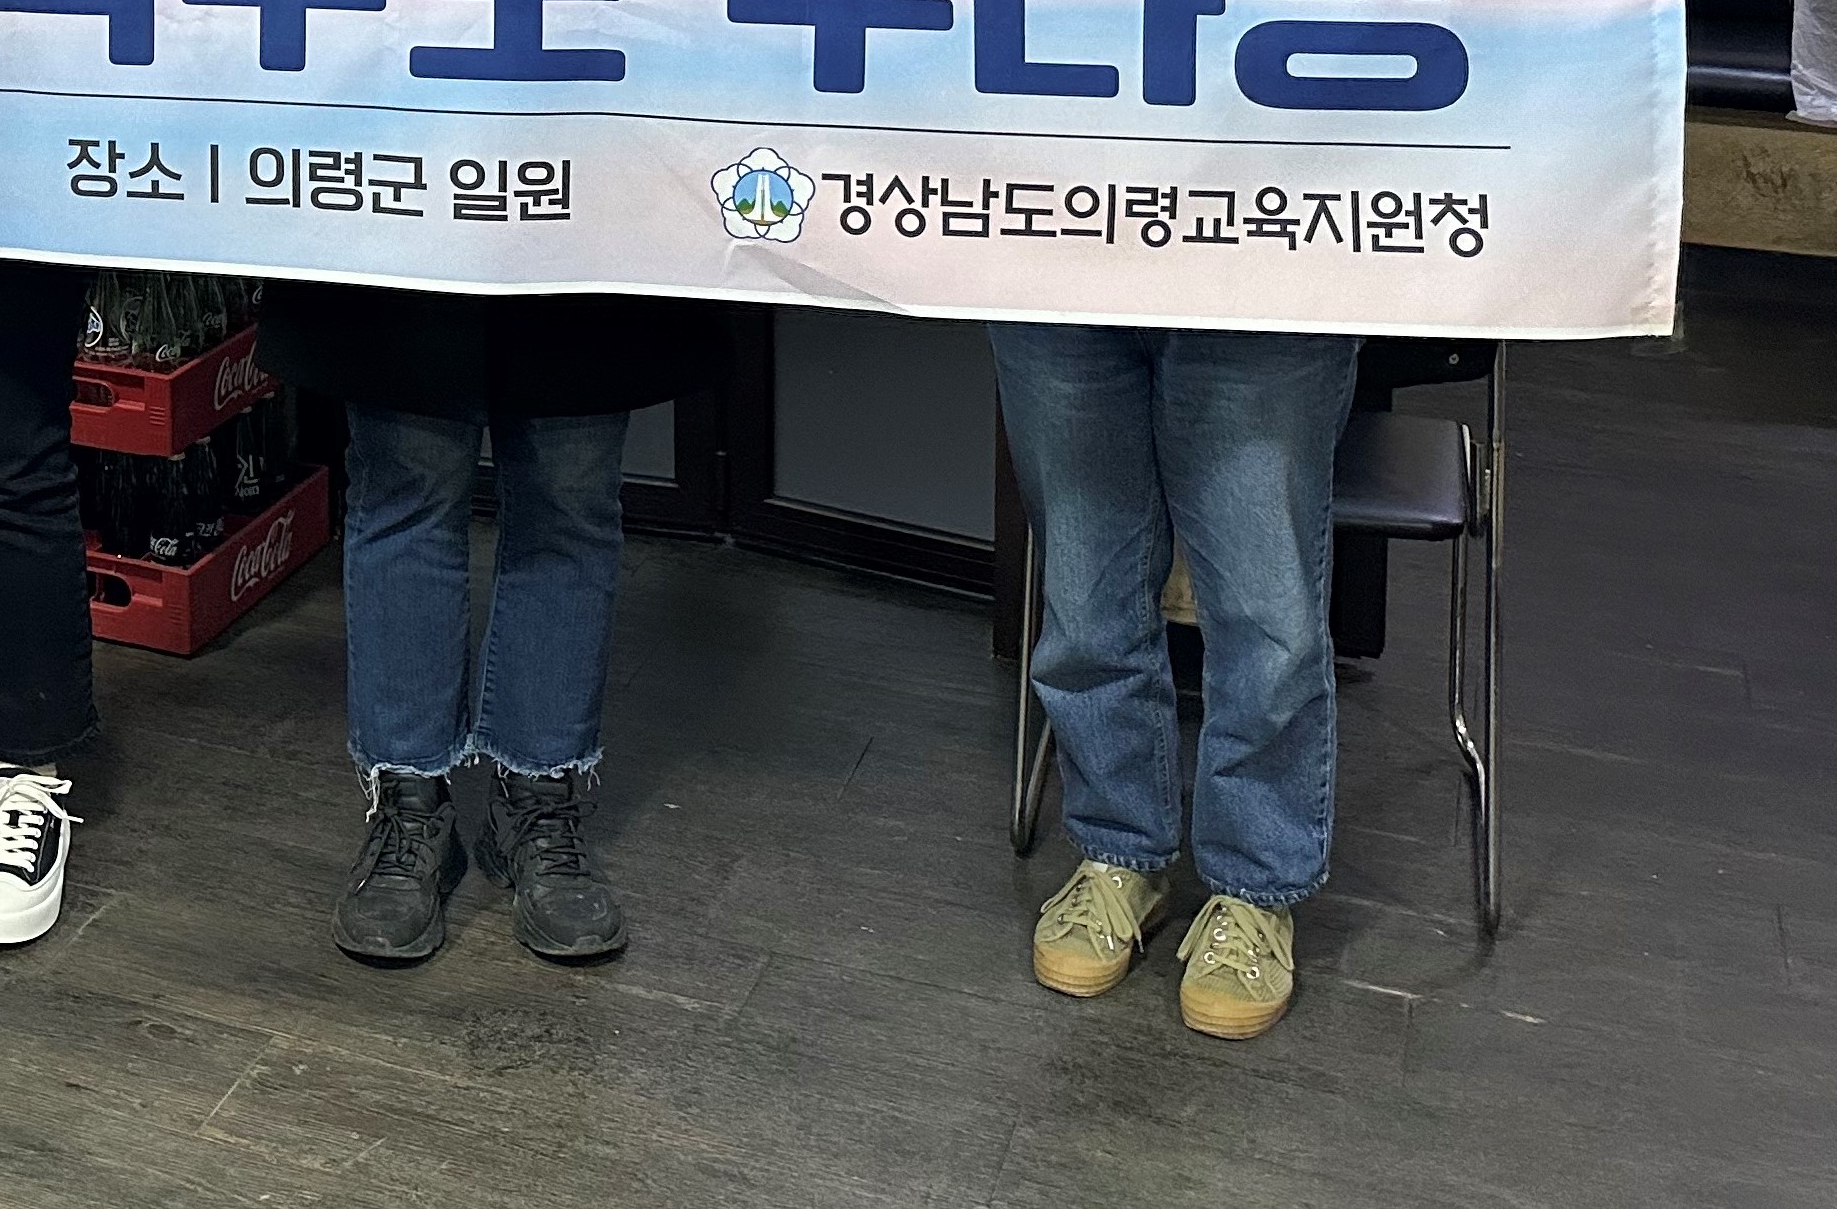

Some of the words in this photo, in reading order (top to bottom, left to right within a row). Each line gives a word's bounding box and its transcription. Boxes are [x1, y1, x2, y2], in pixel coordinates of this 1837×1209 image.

[65, 137, 186, 202] 장소
[244, 146, 429, 219] 의령군
[448, 158, 572, 223] 일원
[820, 171, 1490, 259] 경상남도의령교육지원청
